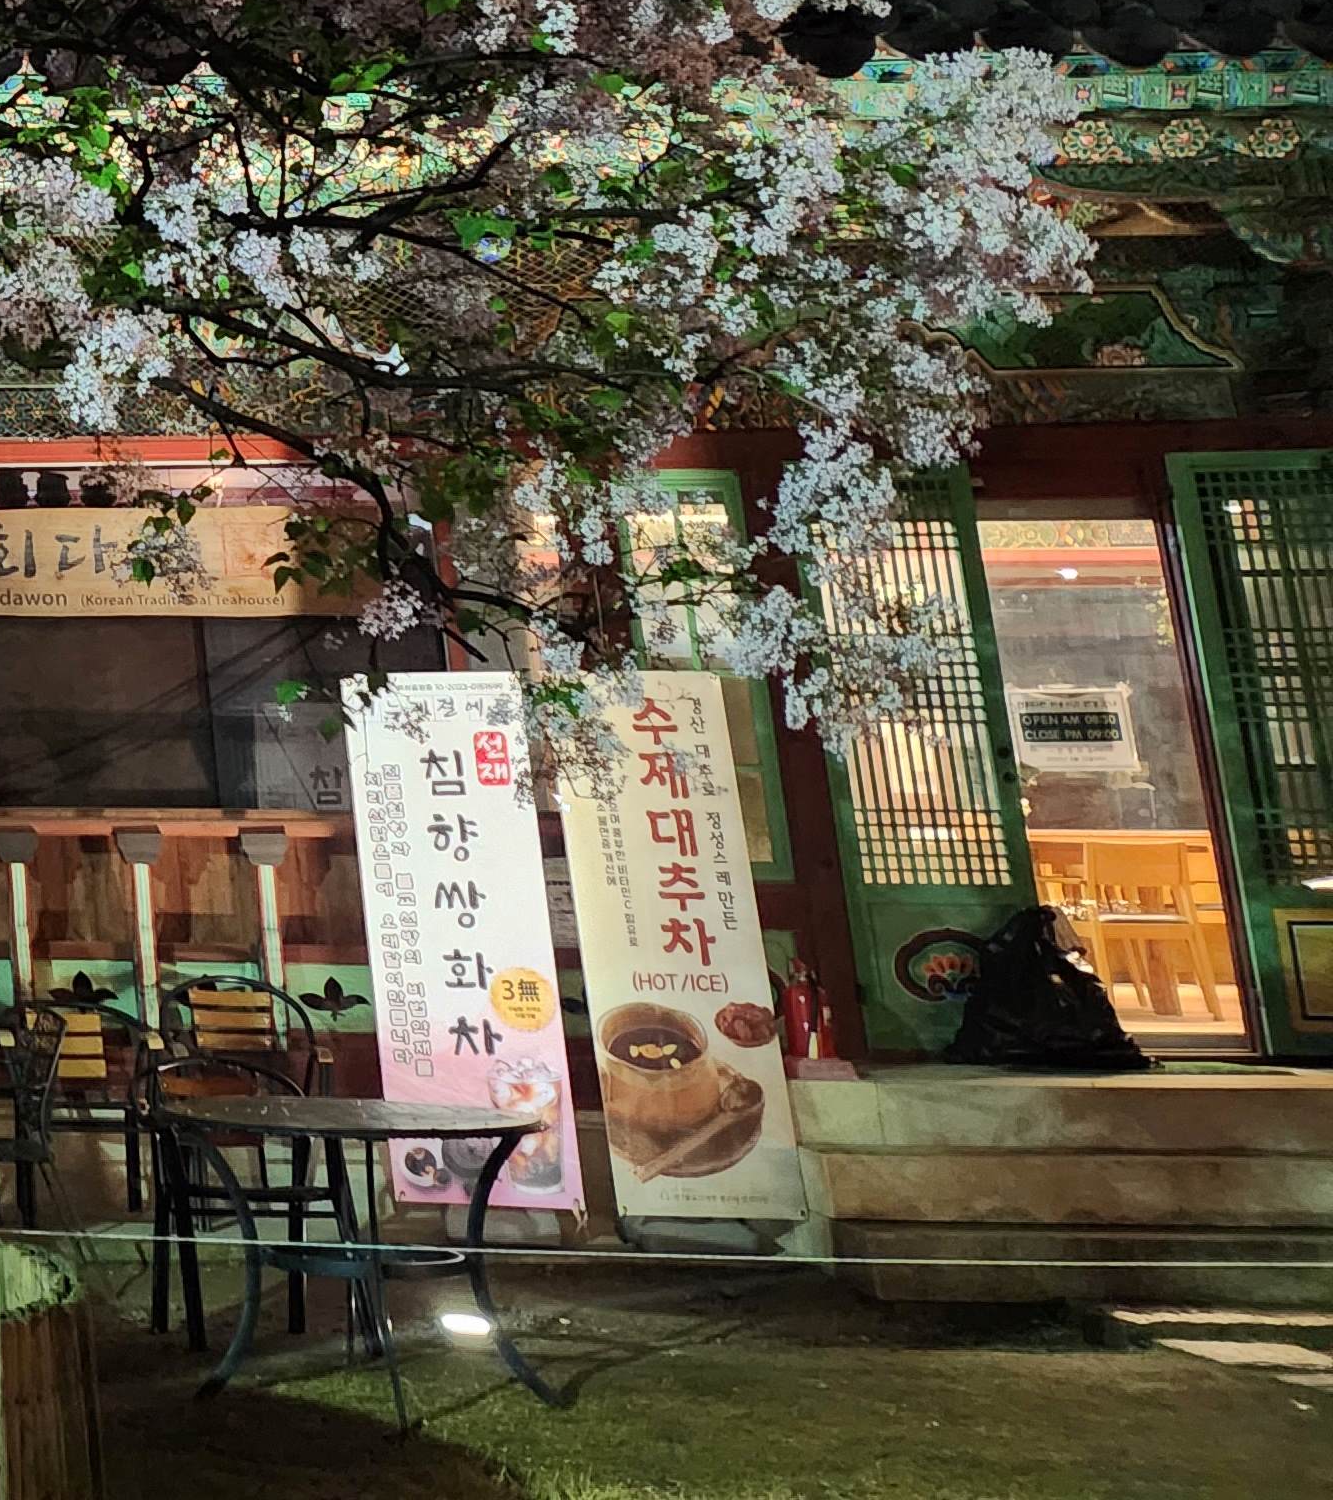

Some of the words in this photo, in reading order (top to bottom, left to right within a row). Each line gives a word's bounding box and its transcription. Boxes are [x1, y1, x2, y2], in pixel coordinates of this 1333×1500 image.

[137, 594, 207, 606] Tradital
[1021, 714, 1060, 727] OPEN
[1061, 714, 1081, 726] AM
[1024, 729, 1062, 741] CLOSE
[633, 698, 717, 967] 수제대추차
[632, 971, 730, 994] (HOT/ICE)
